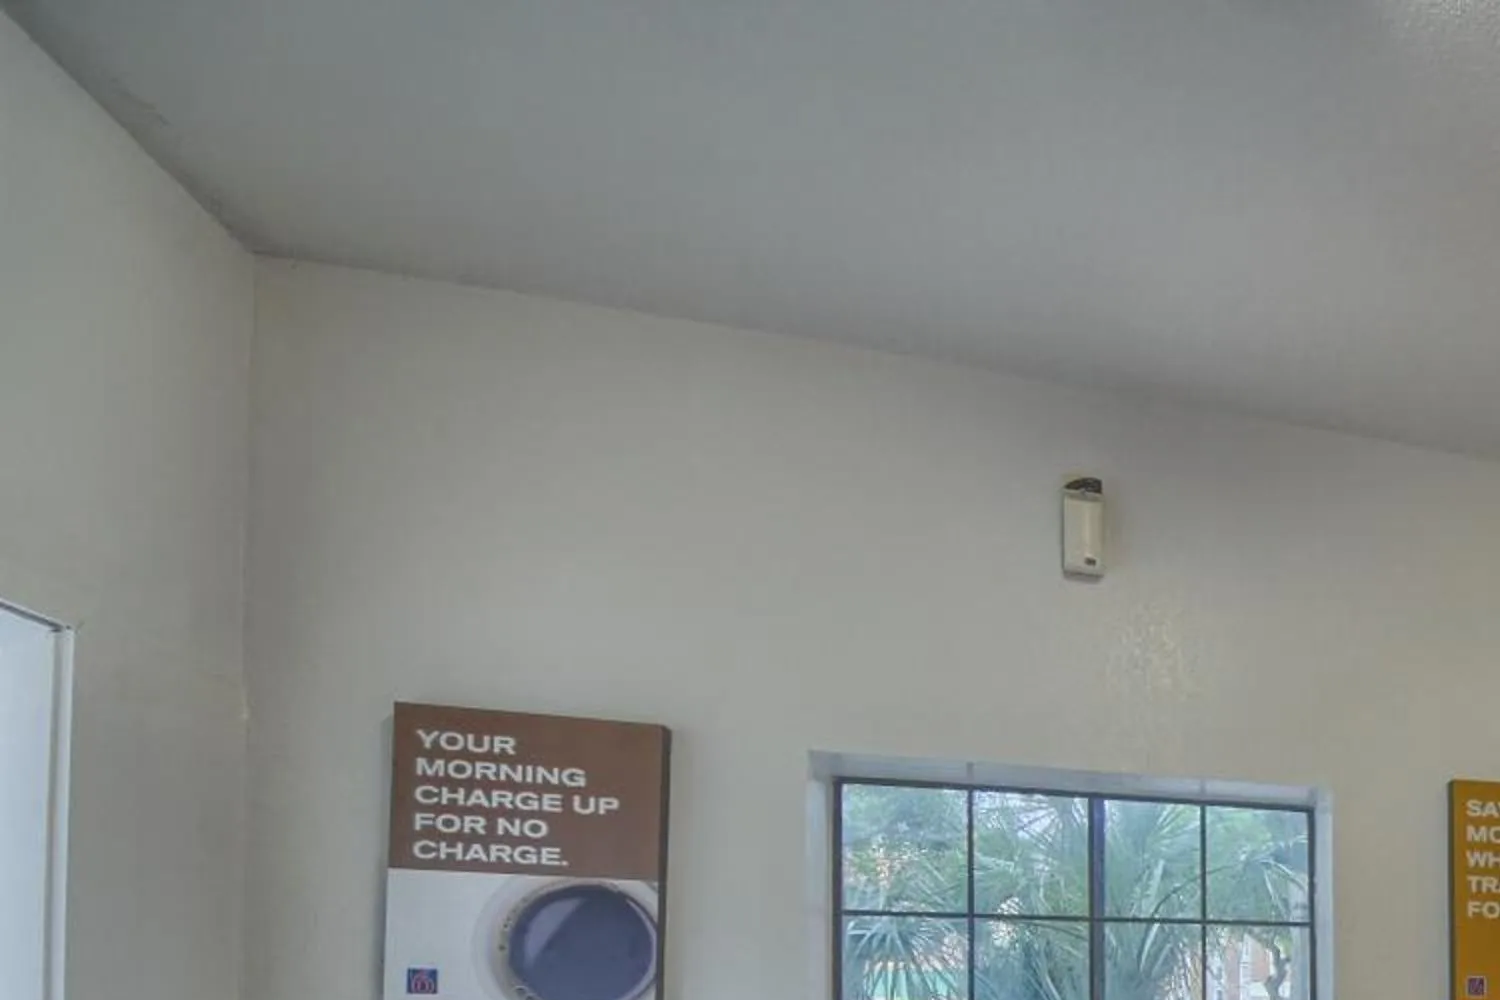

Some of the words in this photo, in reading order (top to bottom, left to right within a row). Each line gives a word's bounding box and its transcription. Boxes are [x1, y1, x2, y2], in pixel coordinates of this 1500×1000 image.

[415, 729, 516, 755] YOUR
[415, 757, 587, 788] MORNING
[414, 785, 563, 813] CHARGE
[572, 796, 620, 815] UP
[413, 812, 486, 835] FOR
[496, 818, 548, 838] NO
[412, 840, 569, 867] CHARGE.
